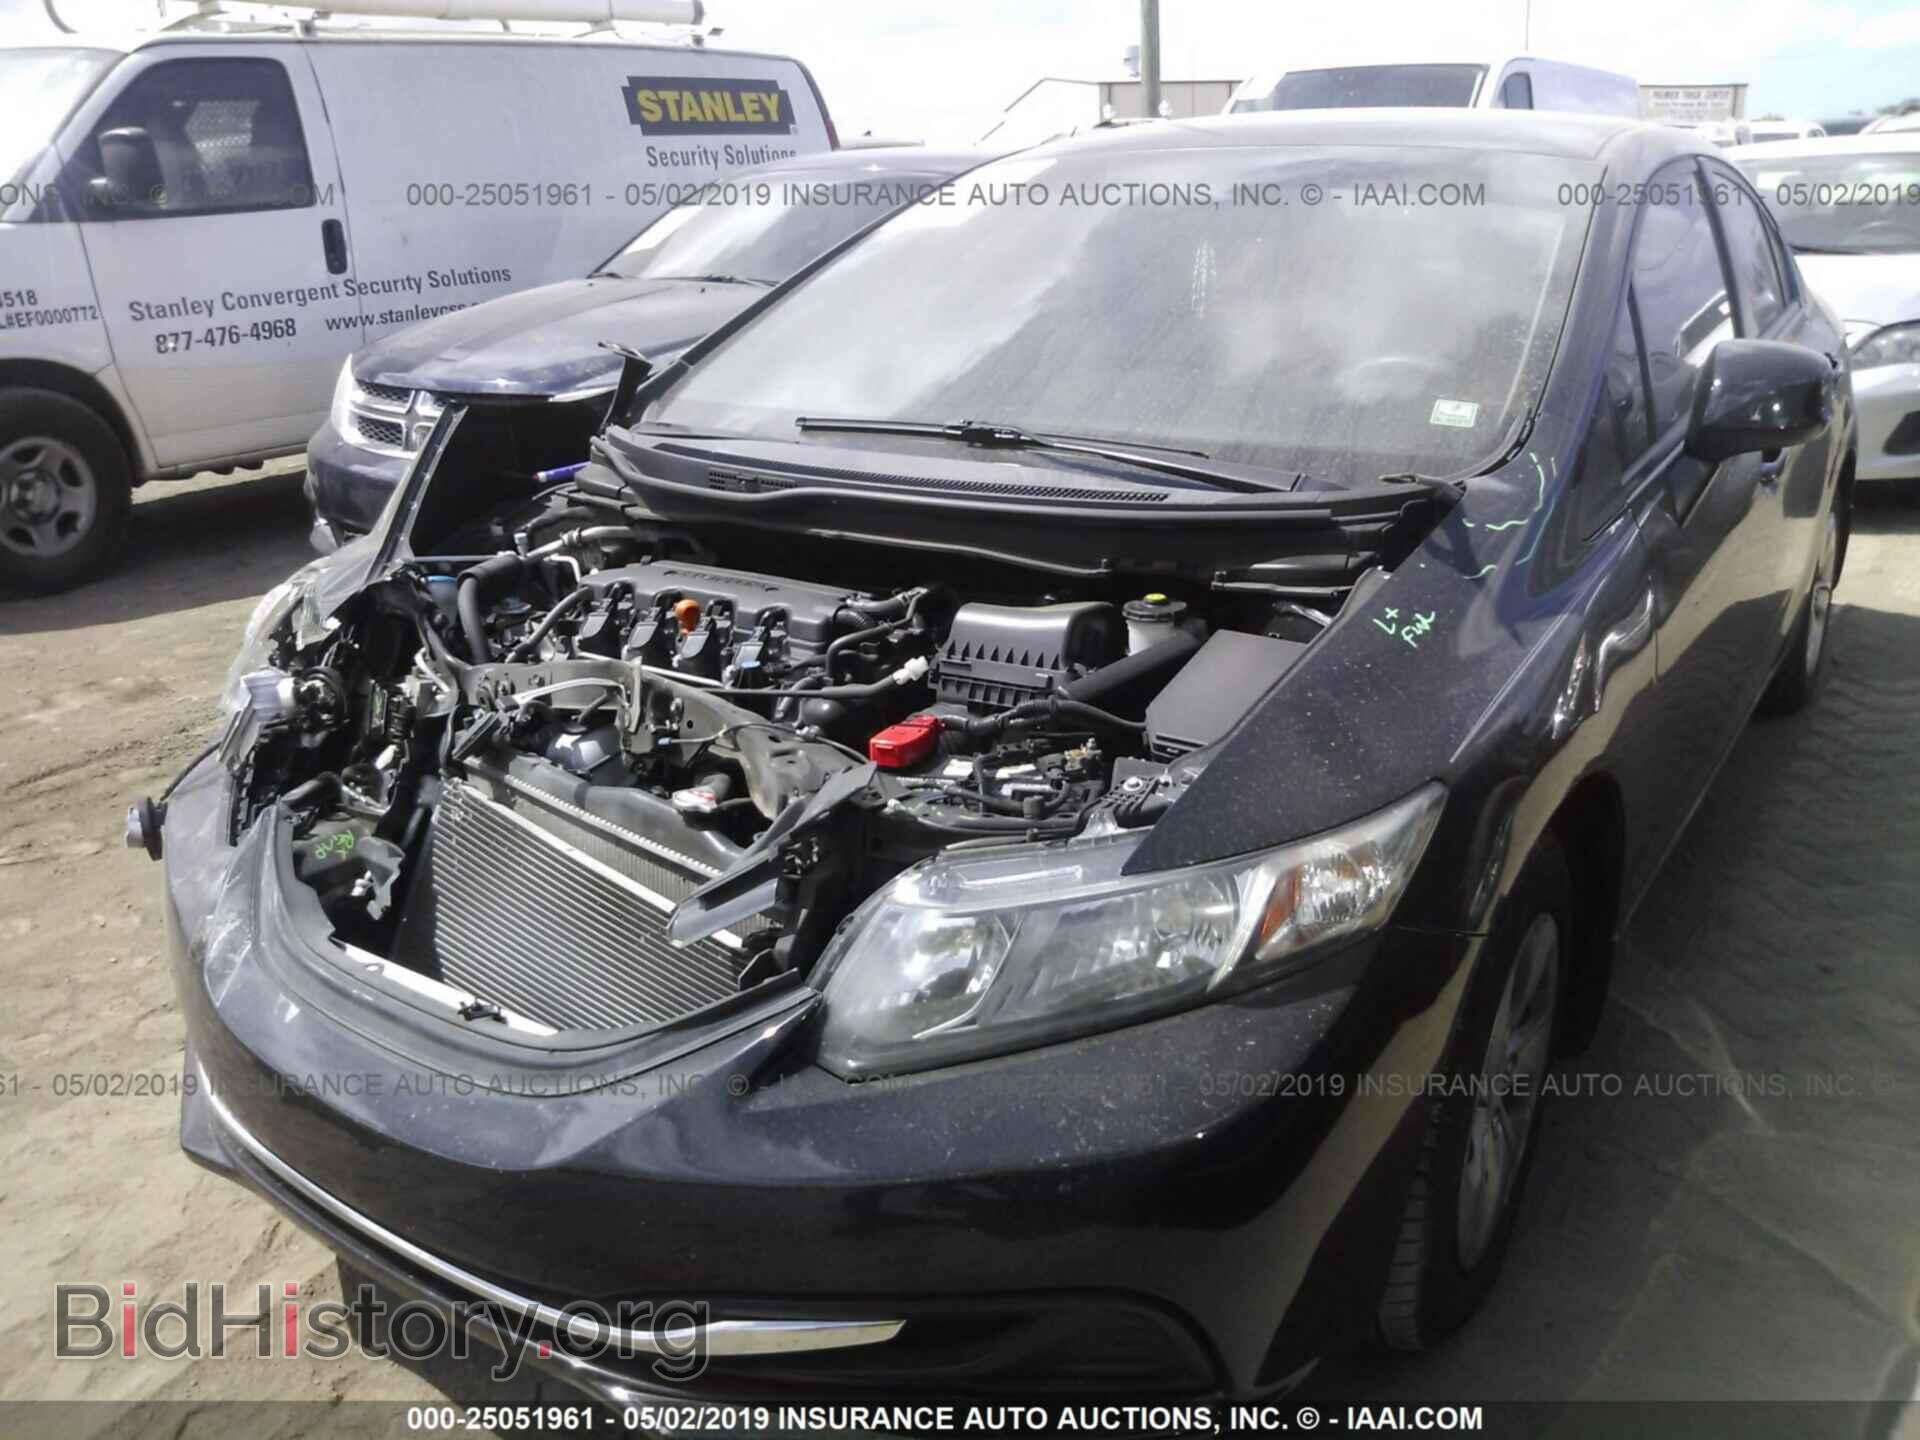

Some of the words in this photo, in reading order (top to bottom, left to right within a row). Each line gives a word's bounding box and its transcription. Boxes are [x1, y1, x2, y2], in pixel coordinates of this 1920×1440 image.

[637, 89, 780, 122] STANLEY
[645, 145, 719, 171] Security
[129, 297, 214, 322] Stanley
[221, 282, 340, 311] Convergent
[343, 276, 422, 297] Security
[428, 267, 512, 289] Solutions
[155, 317, 297, 354] 877-476-4968
